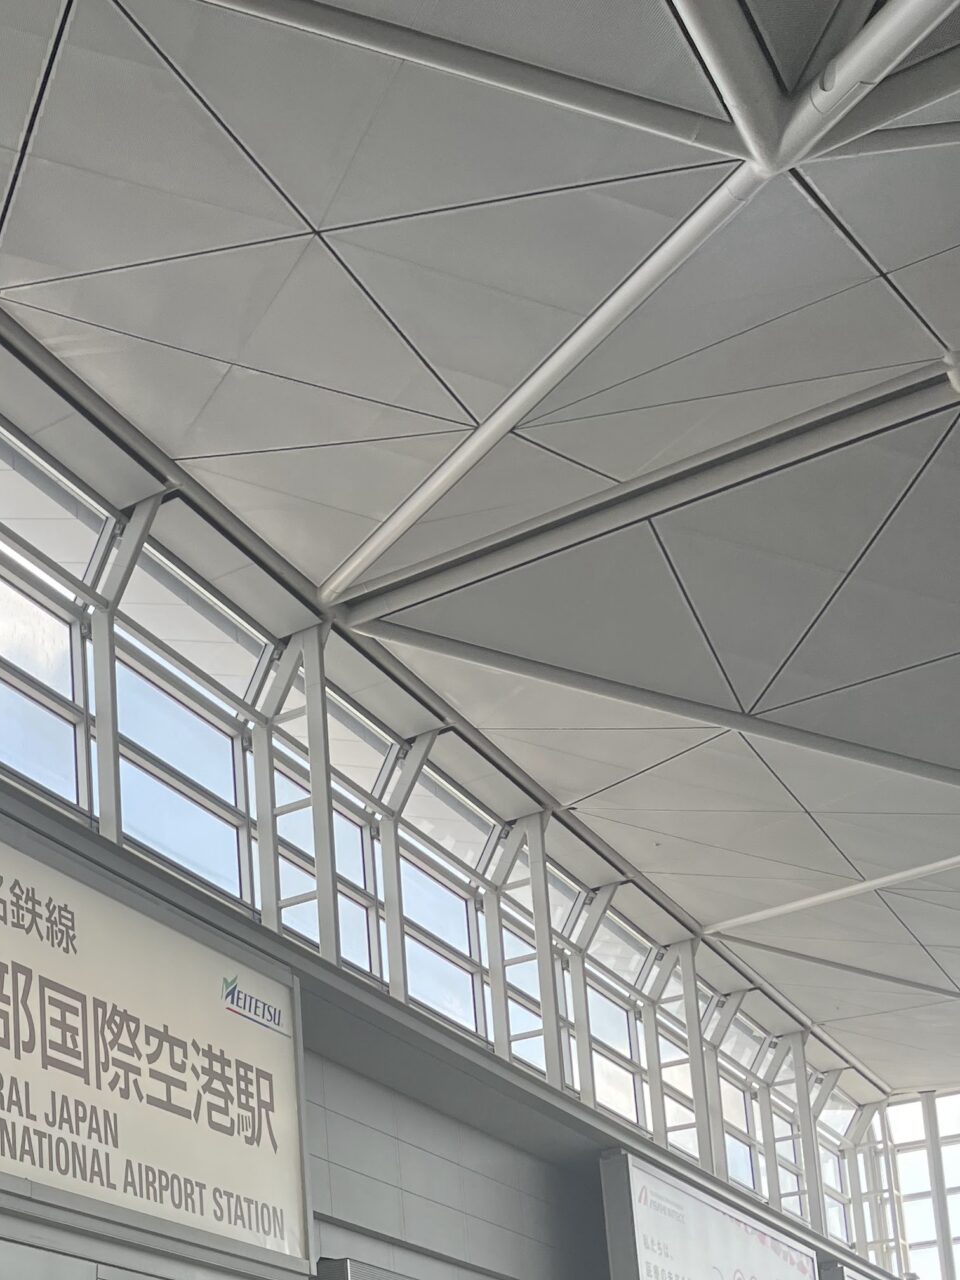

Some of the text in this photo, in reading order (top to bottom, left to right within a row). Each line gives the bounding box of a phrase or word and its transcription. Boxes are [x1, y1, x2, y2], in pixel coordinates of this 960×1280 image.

[221, 975, 282, 1027] MEITETSU
[44, 1090, 120, 1149] JAPAN
[123, 1159, 207, 1217] AIRPORT
[212, 1187, 285, 1241] STATION
